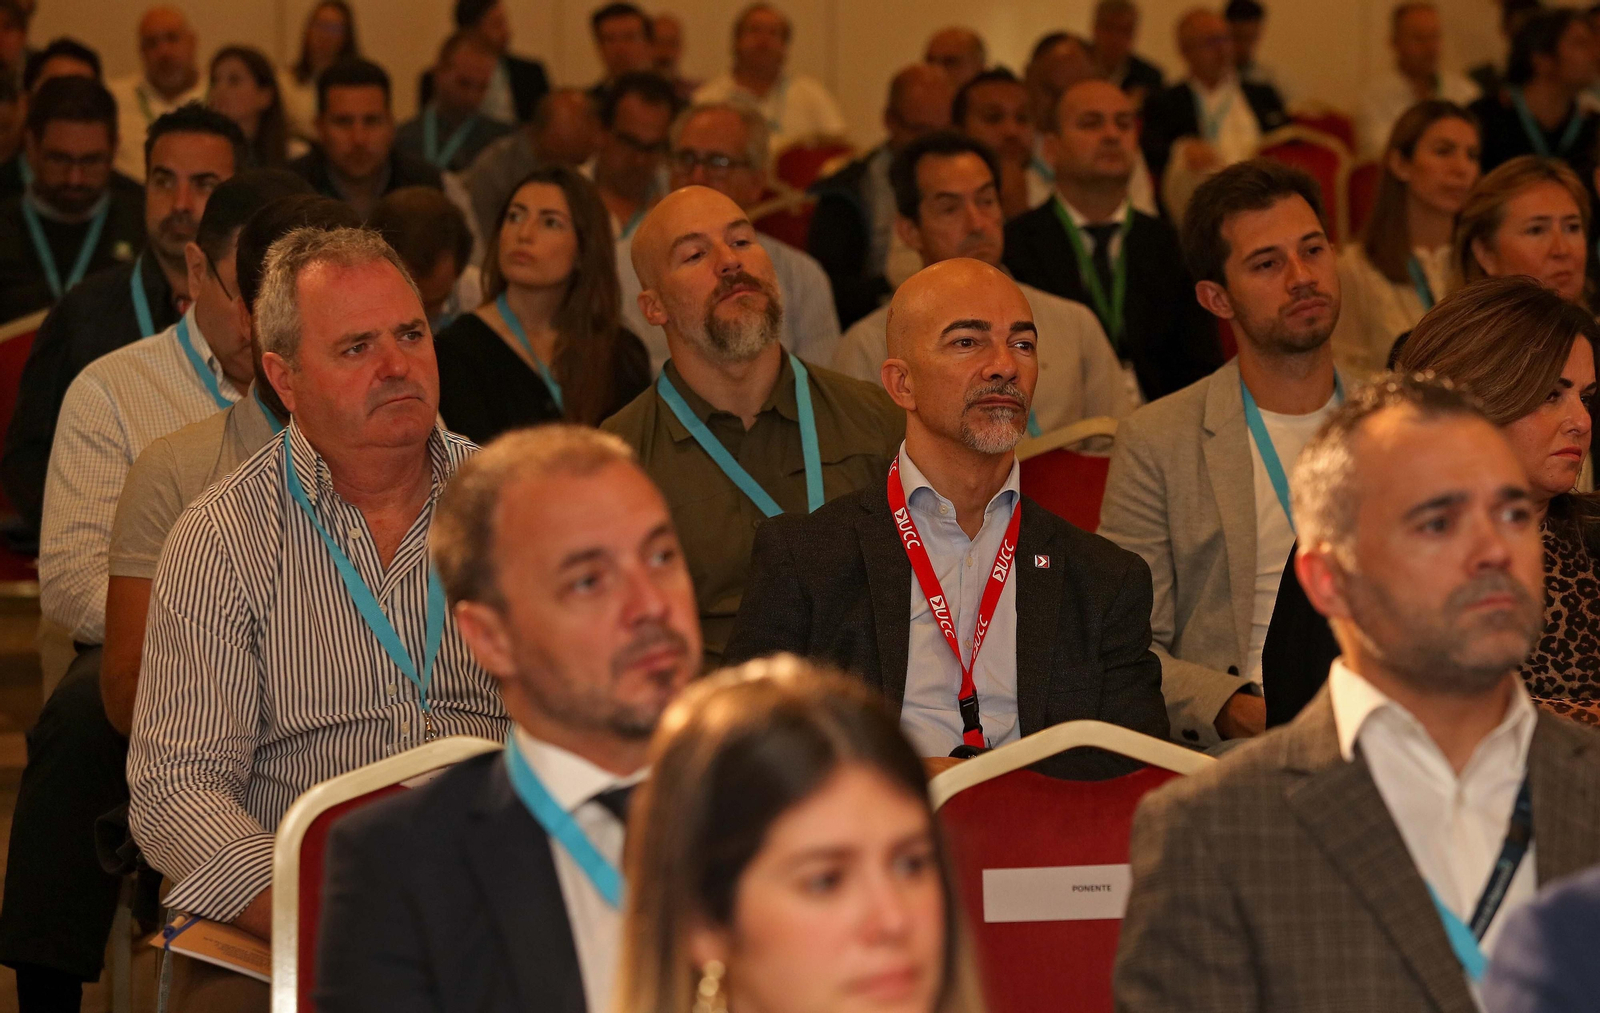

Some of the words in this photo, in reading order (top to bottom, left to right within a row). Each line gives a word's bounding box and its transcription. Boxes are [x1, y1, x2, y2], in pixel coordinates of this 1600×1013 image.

[899, 519, 921, 550] UCC
[996, 539, 1015, 570] UCC
[934, 609, 955, 639] UCC
[1072, 884, 1111, 893] PONENTE
